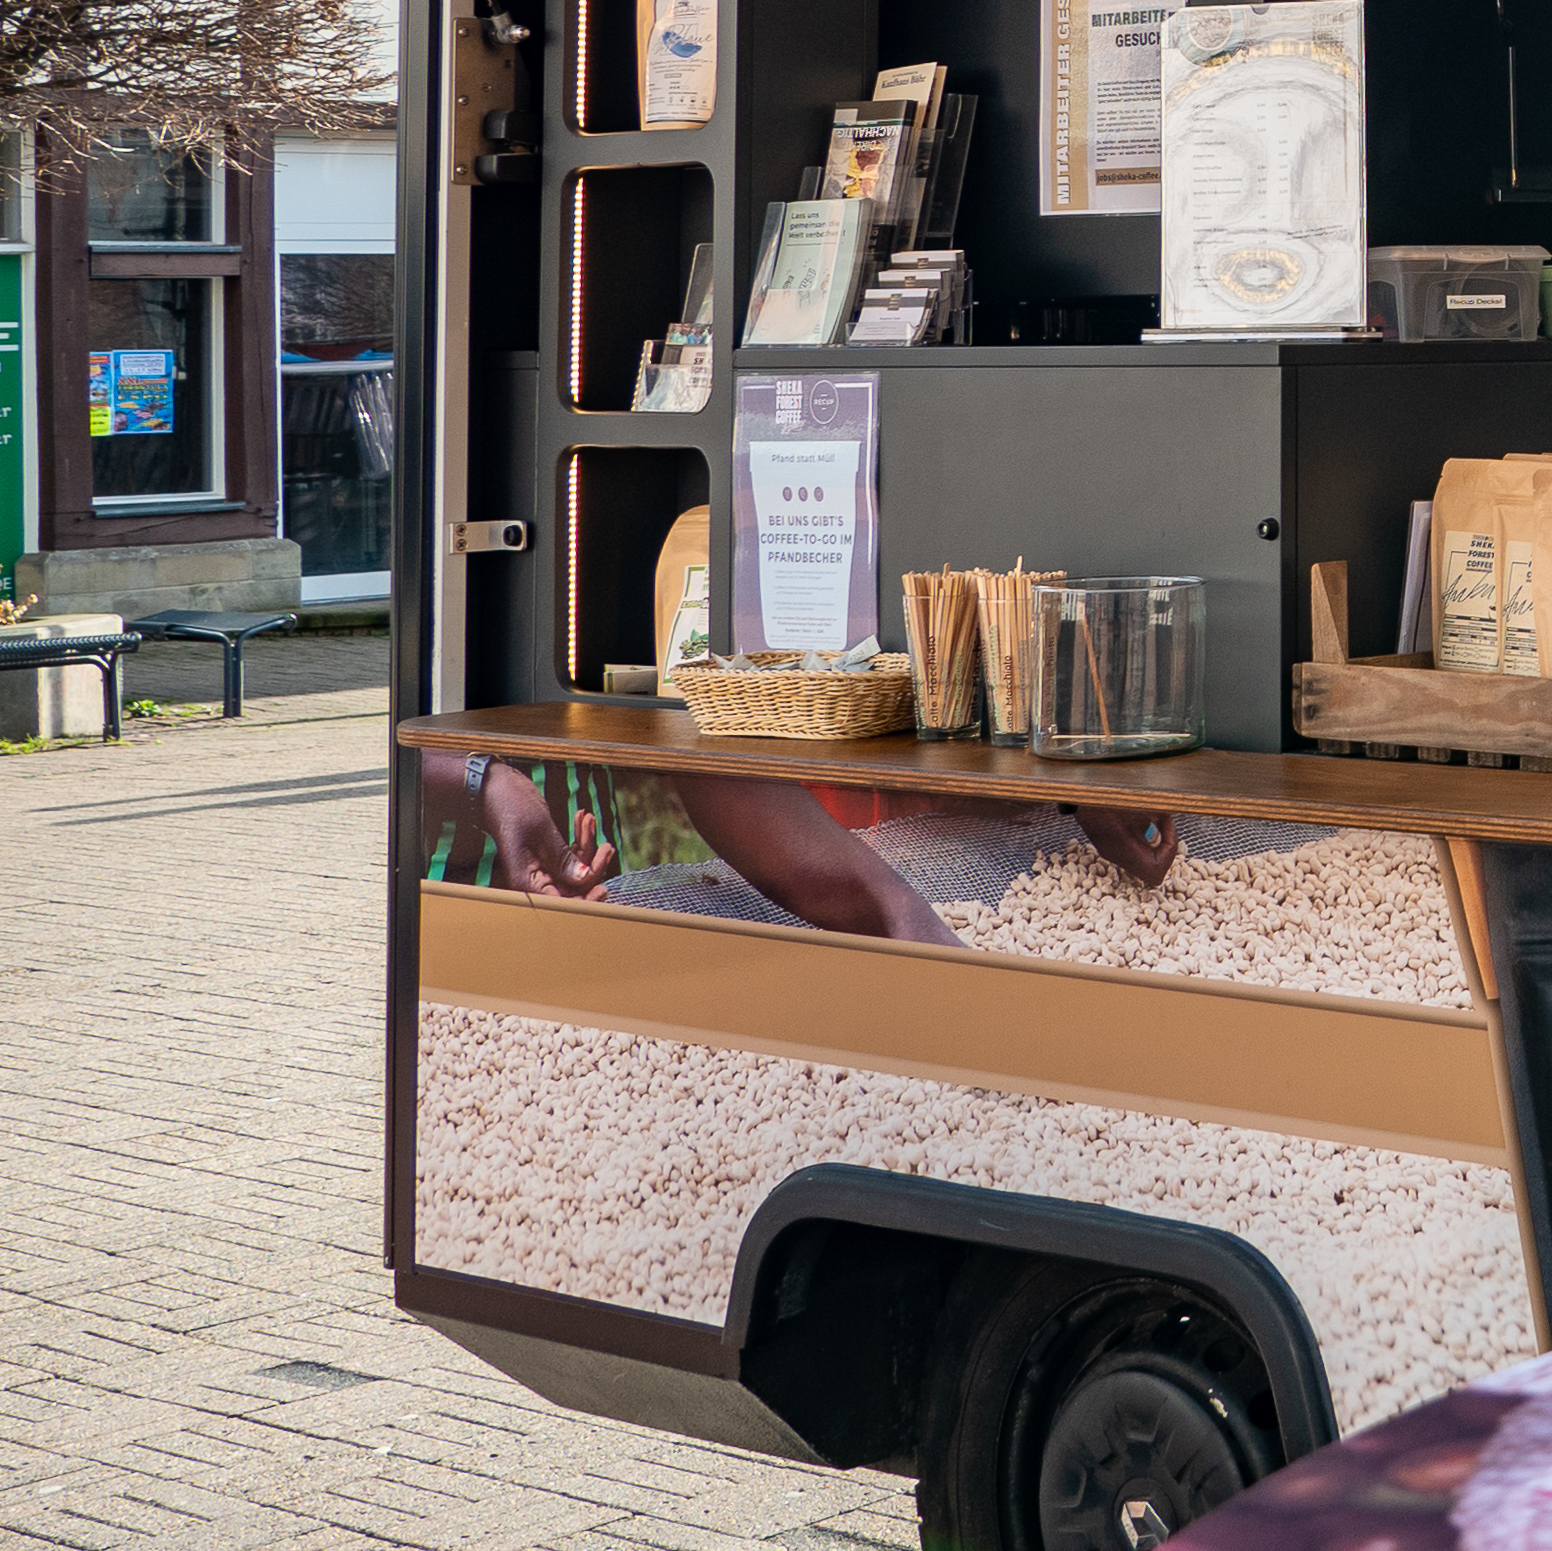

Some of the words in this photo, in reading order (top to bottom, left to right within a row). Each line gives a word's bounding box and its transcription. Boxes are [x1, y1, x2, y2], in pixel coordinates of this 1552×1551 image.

[881, 77, 909, 89] Kaufhaus
[1056, 43, 1072, 205] MITARBEITER
[837, 126, 901, 139] NACHHALTIG
[776, 380, 802, 395] SHEKA
[814, 398, 835, 406] RECUP
[771, 454, 795, 463] Pfand
[796, 454, 816, 463] statt
[818, 453, 836, 463] Müll
[768, 515, 785, 526] BEI
[788, 515, 809, 526] UNS
[812, 515, 844, 527] GIBT'S
[760, 533, 837, 545] COFFEE-TO-GO
[840, 534, 853, 545] IM
[1470, 540, 1494, 549] SHEK
[768, 552, 843, 563] PFANDBECHER
[1466, 560, 1493, 569] COFFEE
[927, 635, 938, 697] Macchiato
[1003, 655, 1013, 706] Macchiato
